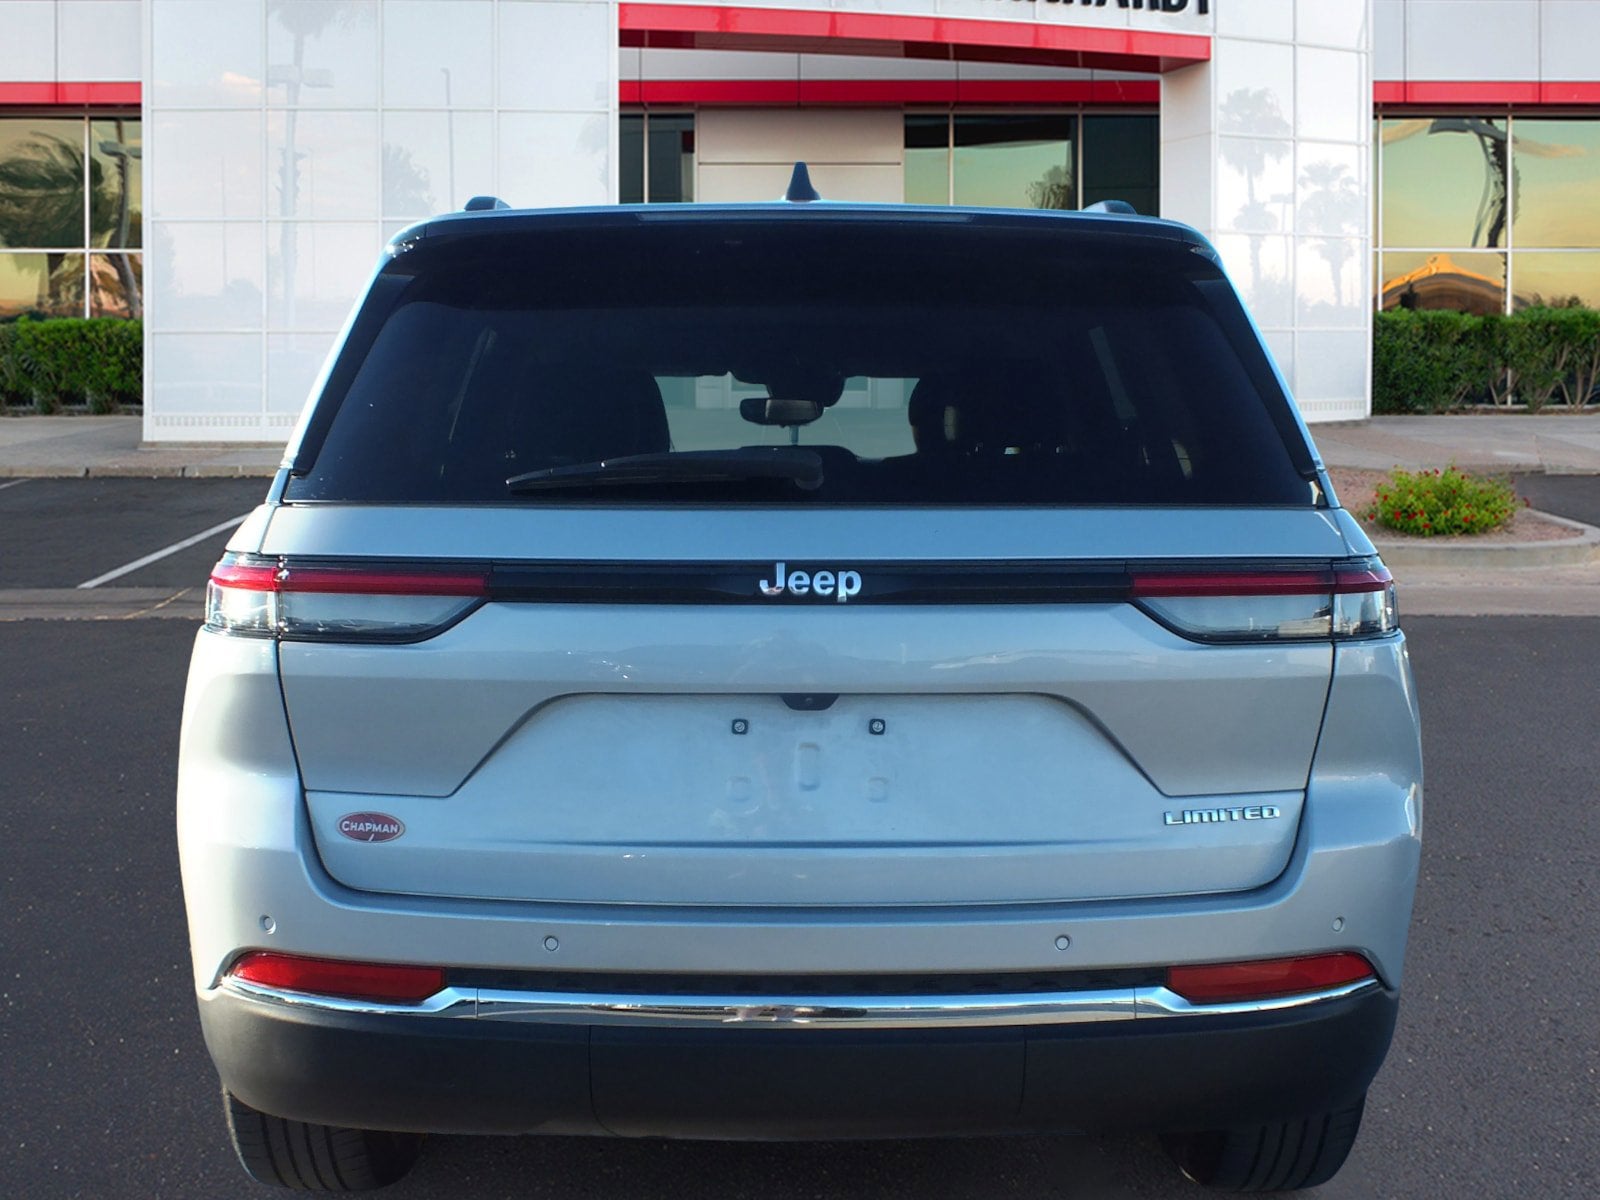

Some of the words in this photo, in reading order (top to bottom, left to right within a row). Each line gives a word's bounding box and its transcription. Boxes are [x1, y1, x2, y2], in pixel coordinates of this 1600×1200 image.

[759, 562, 862, 602] Jeep
[1164, 805, 1280, 825] LIMITED
[341, 820, 399, 833] CHAPMAN
